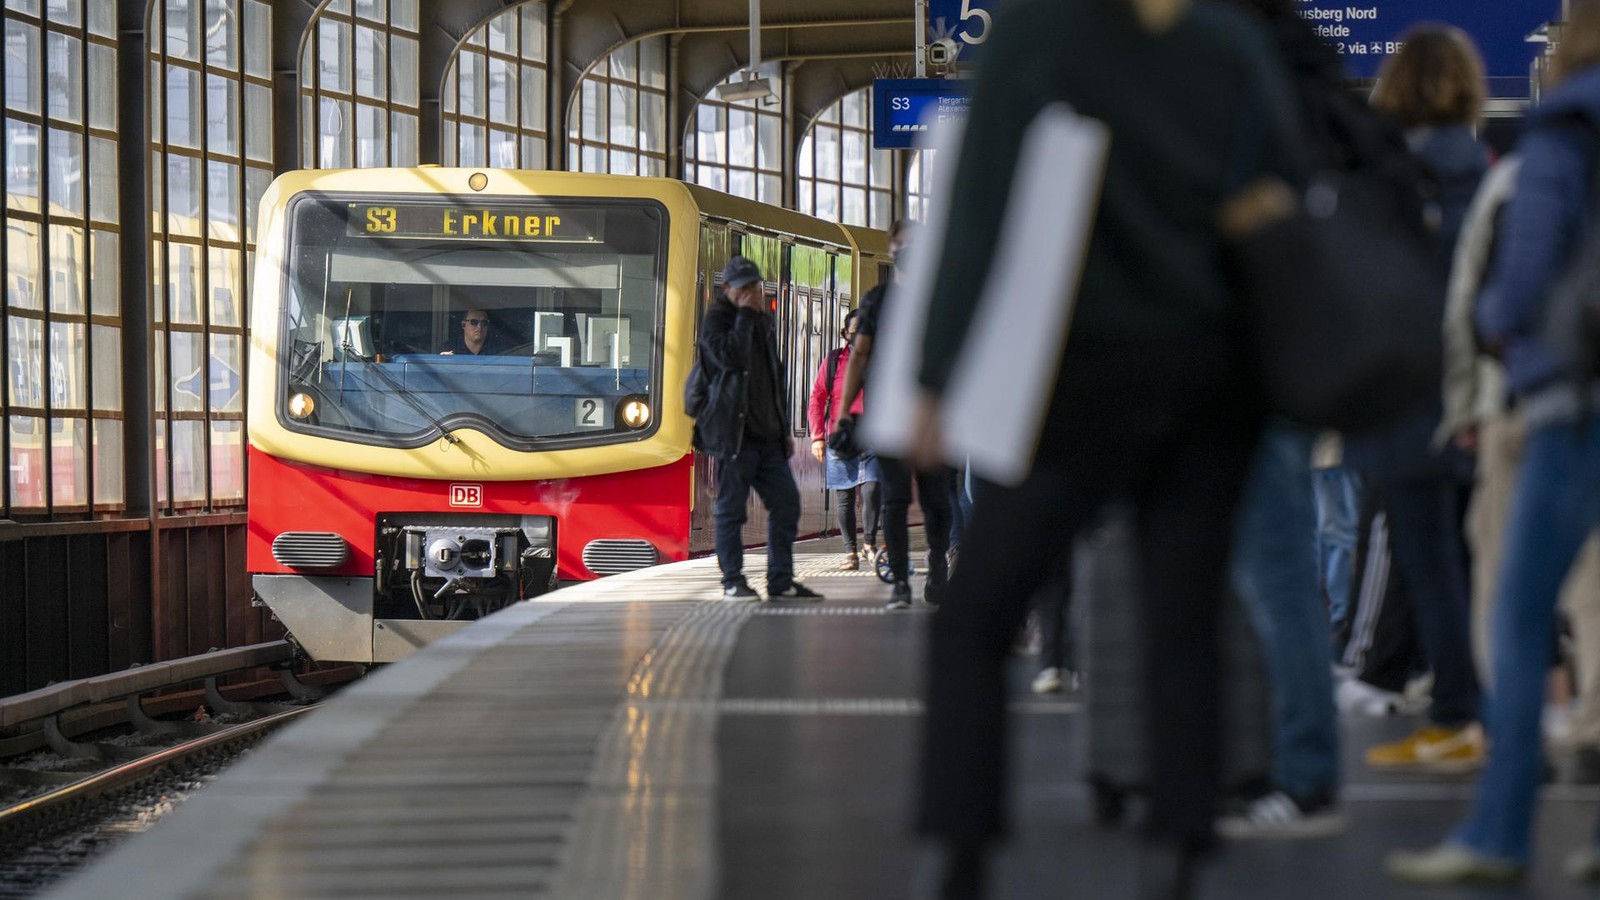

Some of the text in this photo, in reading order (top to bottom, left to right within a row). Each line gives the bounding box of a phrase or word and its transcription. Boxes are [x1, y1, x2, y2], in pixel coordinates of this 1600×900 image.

[1296, 7, 1377, 22] usberg Nord
[959, 0, 992, 45] 5
[1348, 42, 1367, 54] via
[1385, 42, 1407, 54] BE
[892, 97, 910, 110] S3
[938, 96, 976, 105] Tiergarte
[366, 206, 561, 236] S3 Erkner
[582, 399, 597, 425] 2
[454, 487, 479, 503] DB
